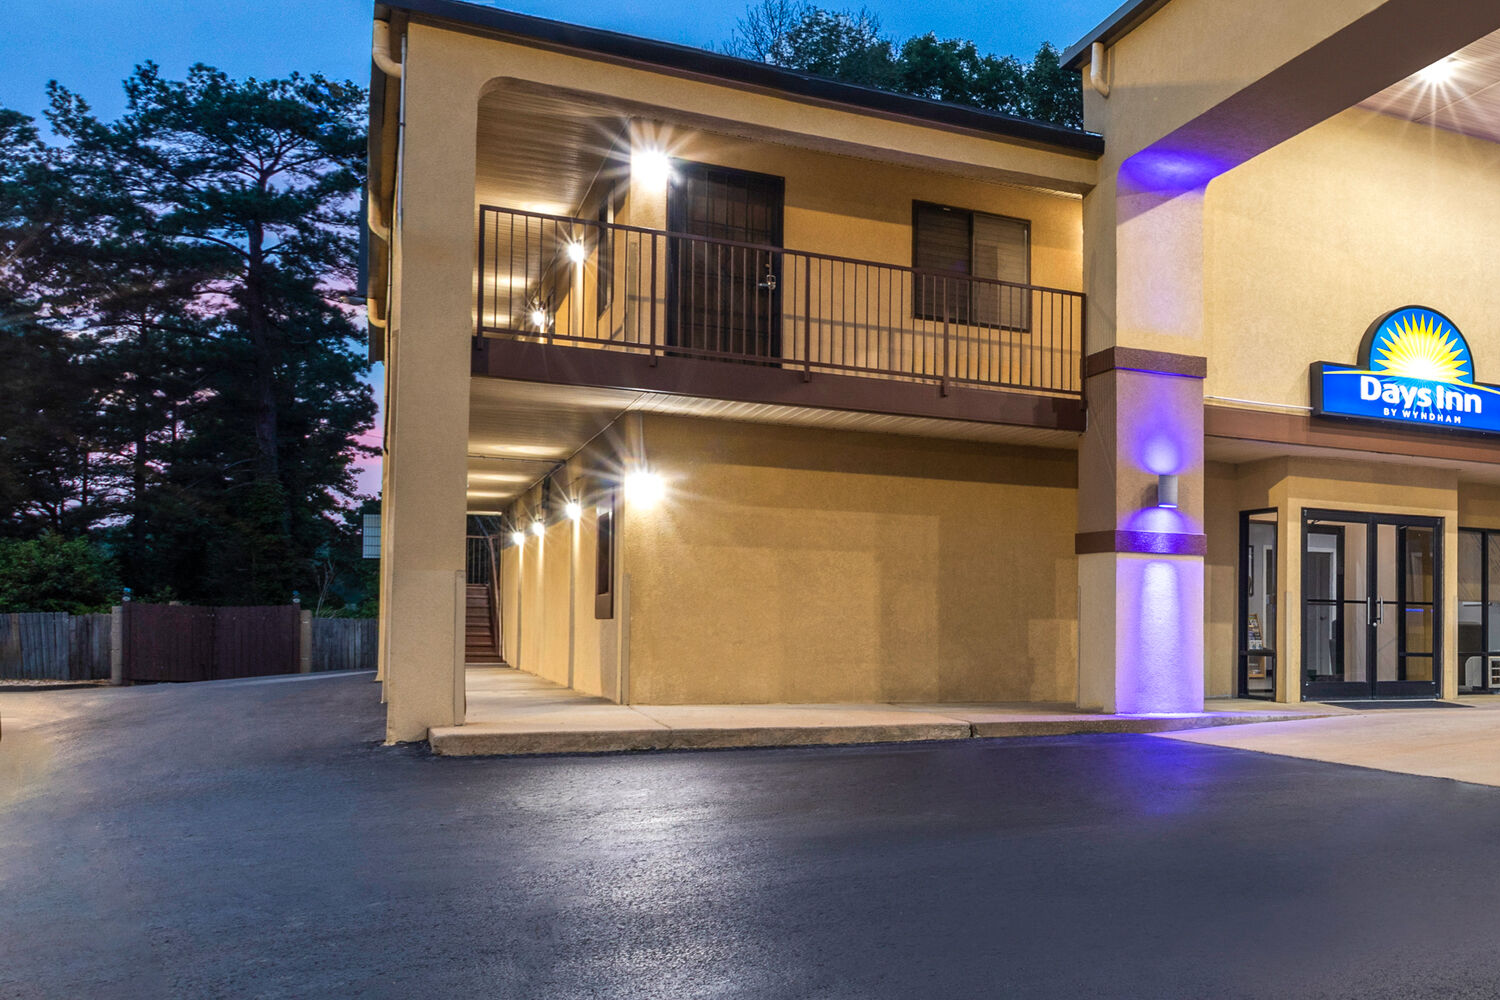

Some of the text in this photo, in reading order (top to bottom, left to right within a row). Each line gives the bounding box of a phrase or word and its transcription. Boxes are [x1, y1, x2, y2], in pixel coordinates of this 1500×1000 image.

[1360, 375, 1482, 414] Days Inn
[1383, 408, 1462, 424] BY WYNDHAM
